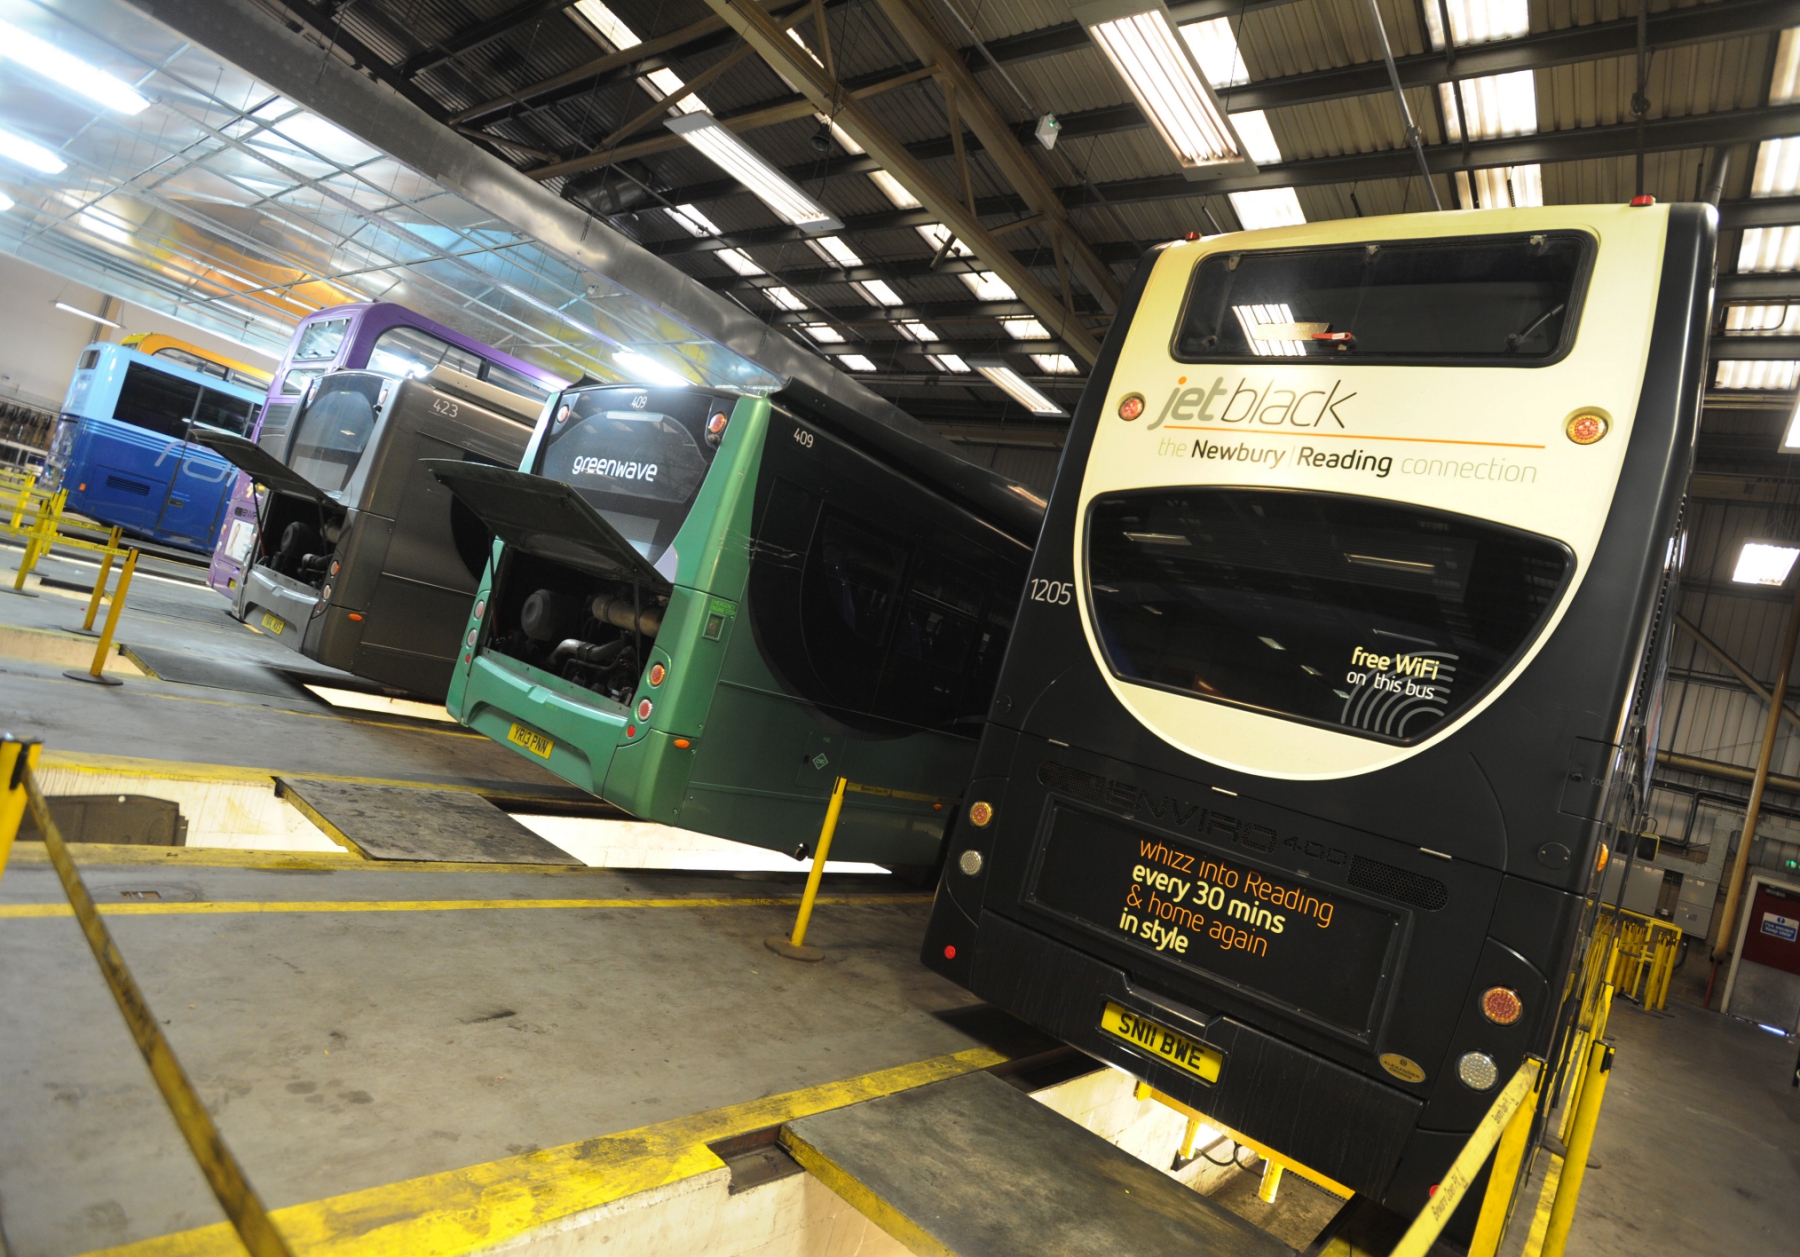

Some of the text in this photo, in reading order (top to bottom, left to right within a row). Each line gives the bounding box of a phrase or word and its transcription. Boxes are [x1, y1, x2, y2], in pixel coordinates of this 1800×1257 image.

[433, 398, 459, 418] 423
[631, 396, 648, 409] 409
[793, 427, 814, 448] 409
[572, 456, 658, 482] greenwave
[1158, 437, 1538, 484] the Newbury Reading connection
[1031, 578, 1074, 605] 1205
[1351, 646, 1440, 681] free WiFi
[1346, 671, 1435, 700] on this bus
[514, 725, 549, 754] YR13 PNN
[1105, 779, 1347, 867] ENVIRO 400
[1132, 864, 1286, 934] every 30 mins
[1140, 840, 1334, 928] whizz into Reading
[1119, 907, 1189, 954] in style
[1126, 884, 1268, 957] & home again
[1118, 1012, 1206, 1071] SN11 BWE
